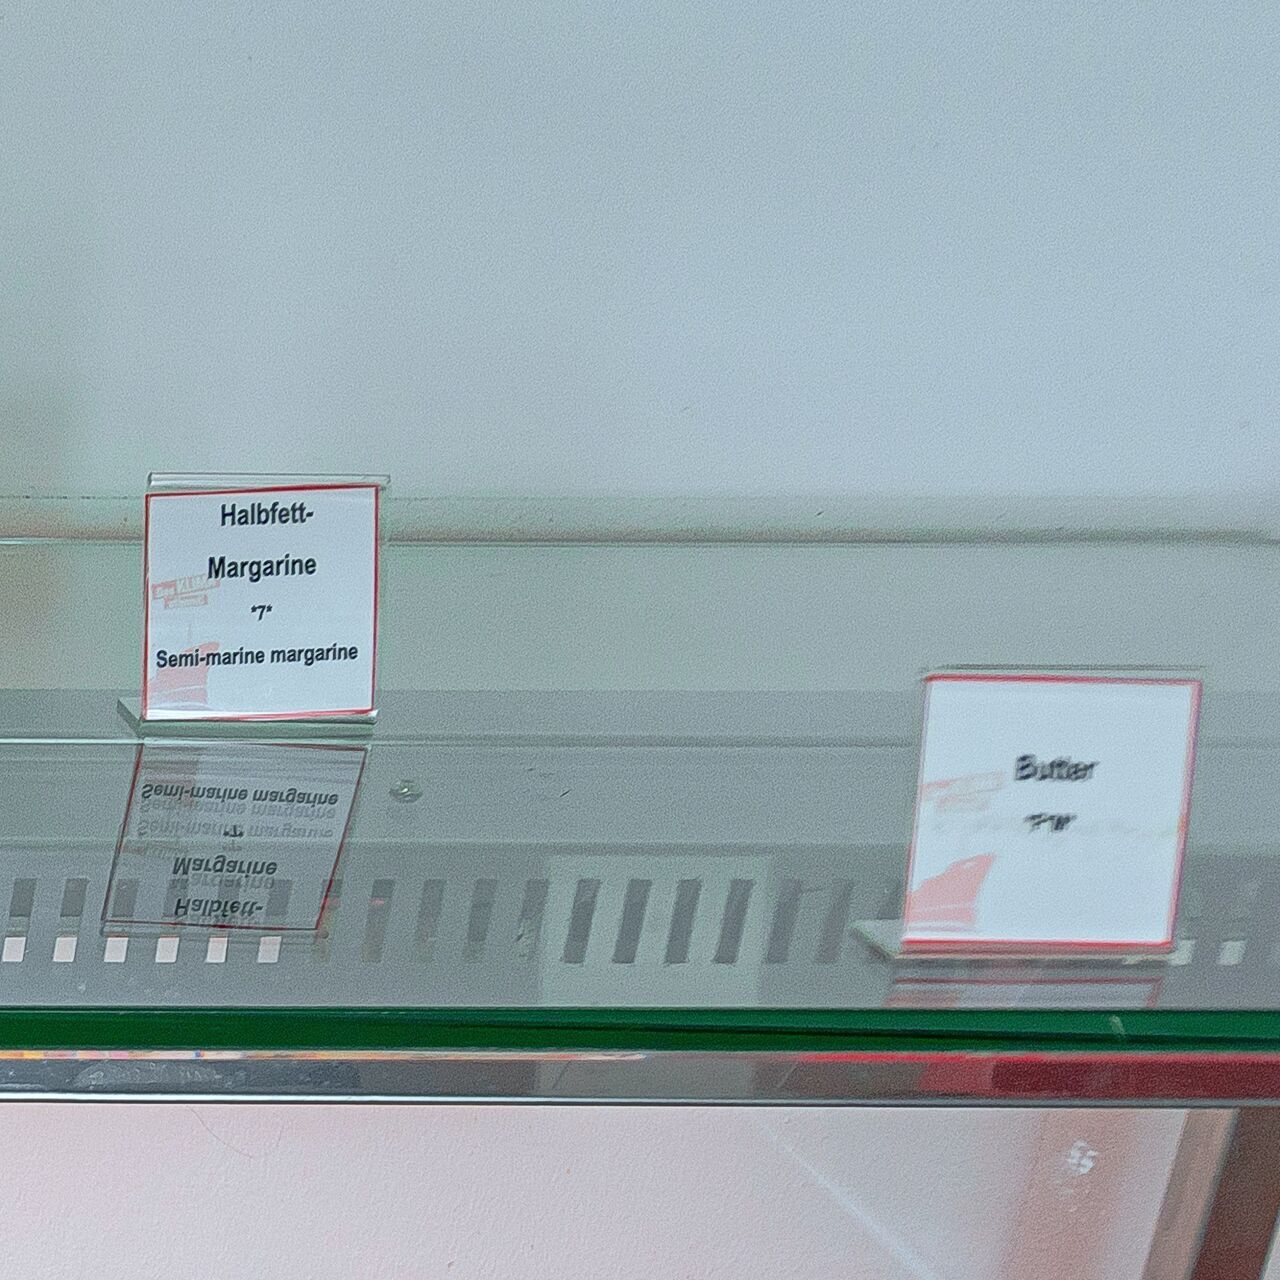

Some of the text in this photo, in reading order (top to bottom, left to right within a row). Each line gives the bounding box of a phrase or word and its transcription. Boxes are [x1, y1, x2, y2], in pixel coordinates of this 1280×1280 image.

[221, 502, 313, 526] Halbfett-
[208, 554, 316, 582] Margarine
[157, 643, 358, 668] Semi-marine margarine
